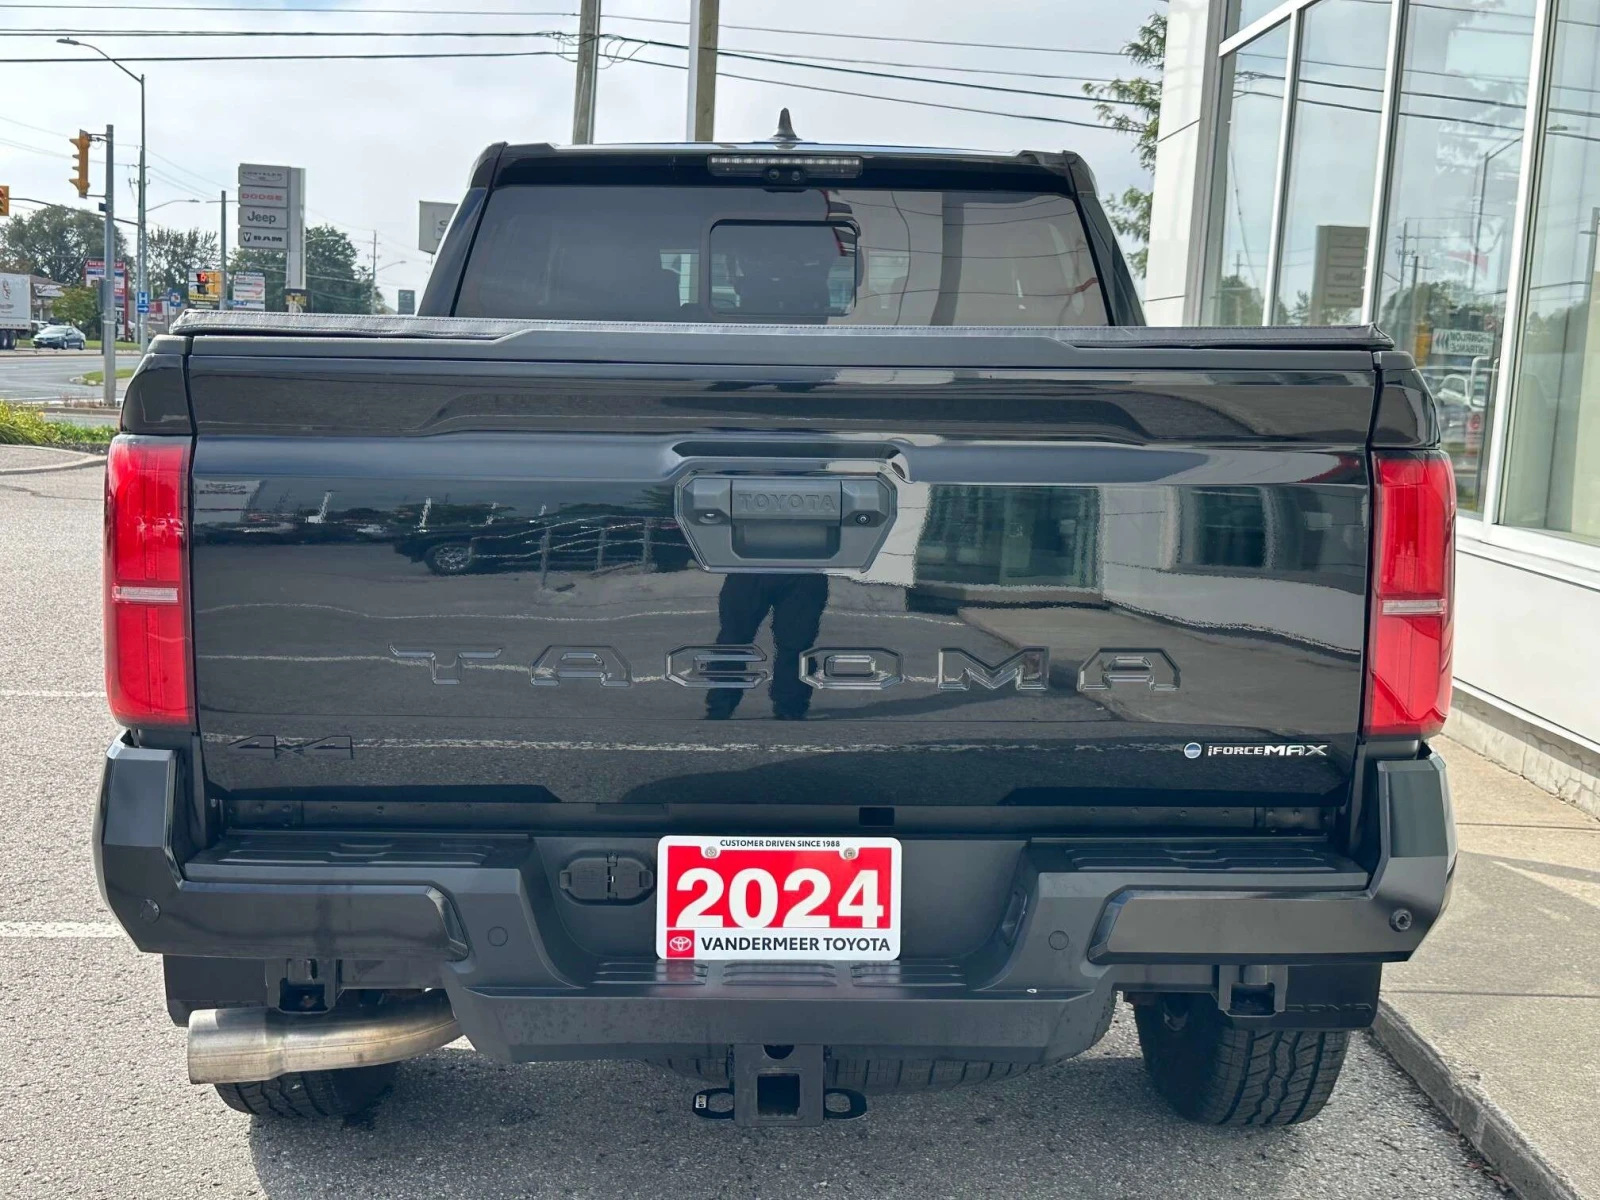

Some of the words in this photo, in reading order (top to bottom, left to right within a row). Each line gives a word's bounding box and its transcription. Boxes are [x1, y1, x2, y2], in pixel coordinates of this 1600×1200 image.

[241, 193, 283, 201] DODGE
[247, 210, 277, 225] Jeep
[138, 293, 149, 305] H
[738, 493, 837, 513] TOYOTA
[388, 643, 1181, 691] TACOMA
[720, 839, 764, 847] CUSTOMER
[765, 840, 796, 848] DRIVEN
[797, 840, 821, 848] SINCE
[822, 840, 841, 848] 1988
[675, 867, 884, 929] 2024
[701, 937, 820, 951] VANDERMEER
[823, 937, 891, 952] TOYOTA
